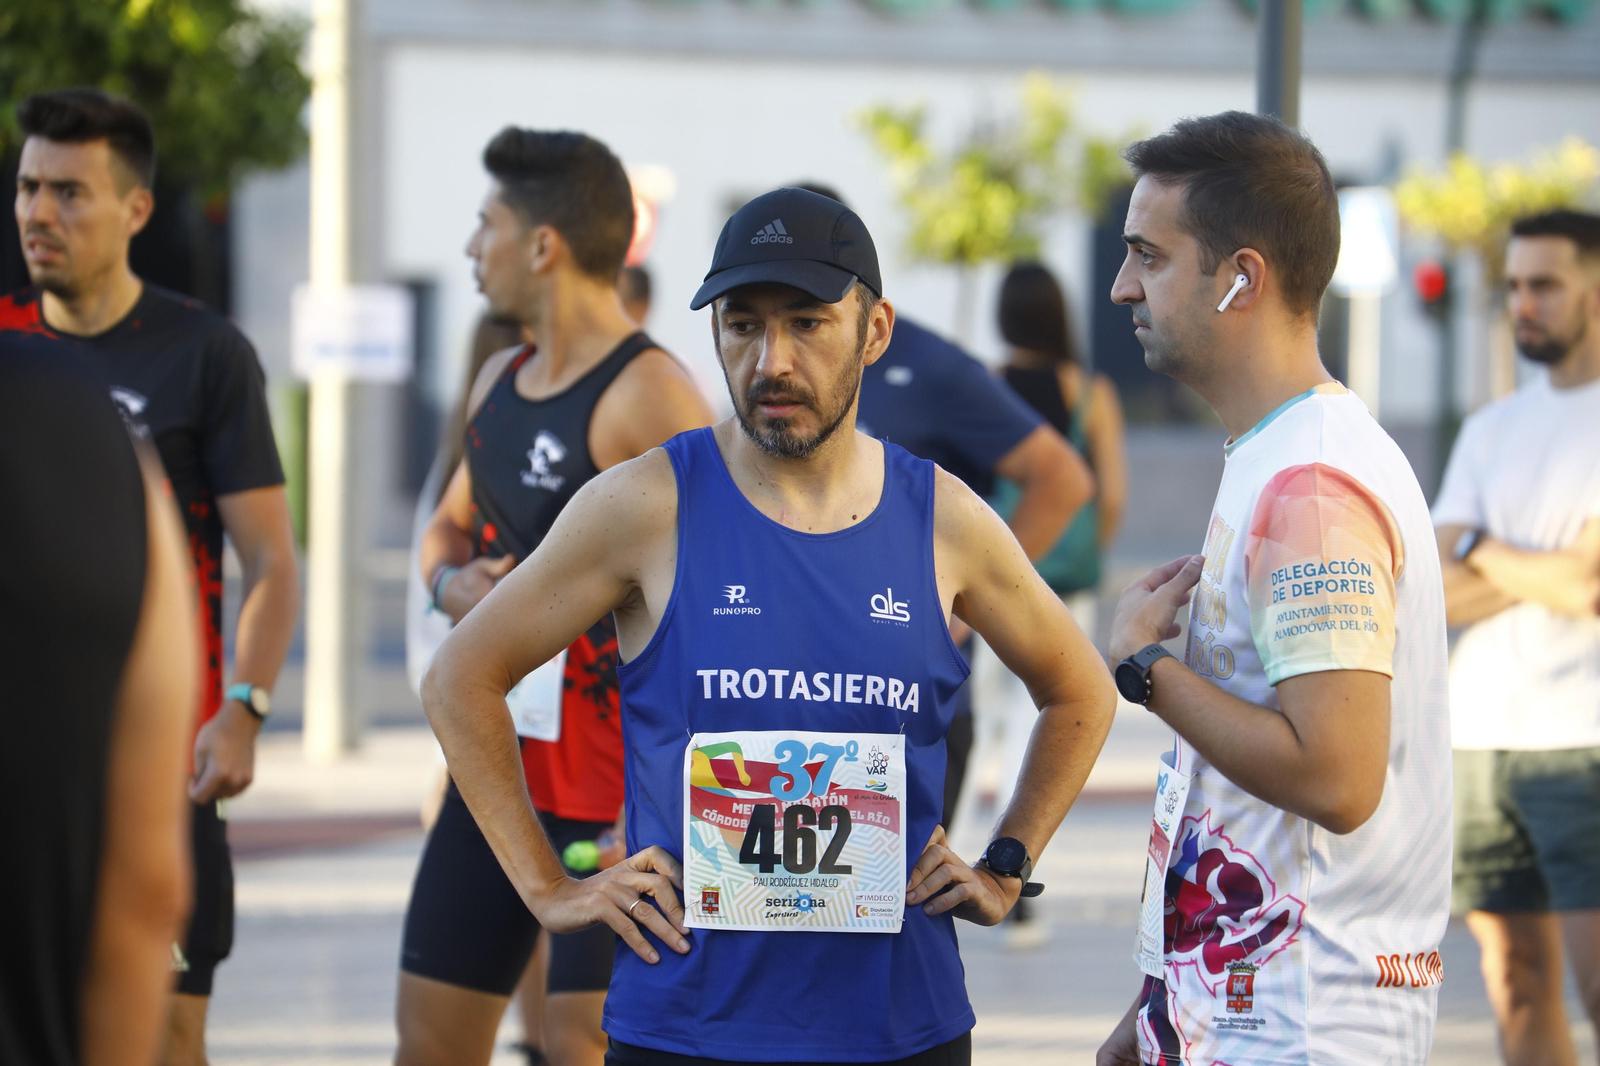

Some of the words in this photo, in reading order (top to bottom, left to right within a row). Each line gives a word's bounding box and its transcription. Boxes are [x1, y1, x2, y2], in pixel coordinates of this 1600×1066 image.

[751, 233, 793, 245] adidas
[1271, 558, 1372, 586] DELEGACIÓN
[1272, 586, 1286, 604] DE
[1292, 579, 1375, 597] DEPORTES
[1276, 604, 1358, 625] AYUNTAMIENTO
[1361, 605, 1374, 616] DE
[1274, 620, 1337, 641] ALMODÓVAR
[1340, 621, 1361, 631] DEL
[1364, 620, 1379, 633] RÍO
[696, 668, 919, 713] TROTASIERRA
[867, 812, 891, 825] RÍO
[739, 804, 852, 874] 462
[754, 877, 768, 887] PAU
[769, 876, 808, 888] RODRÍGUEZ
[810, 878, 838, 888] HIDALGO
[766, 894, 826, 908] serizona
[1376, 954, 1406, 987] NO
